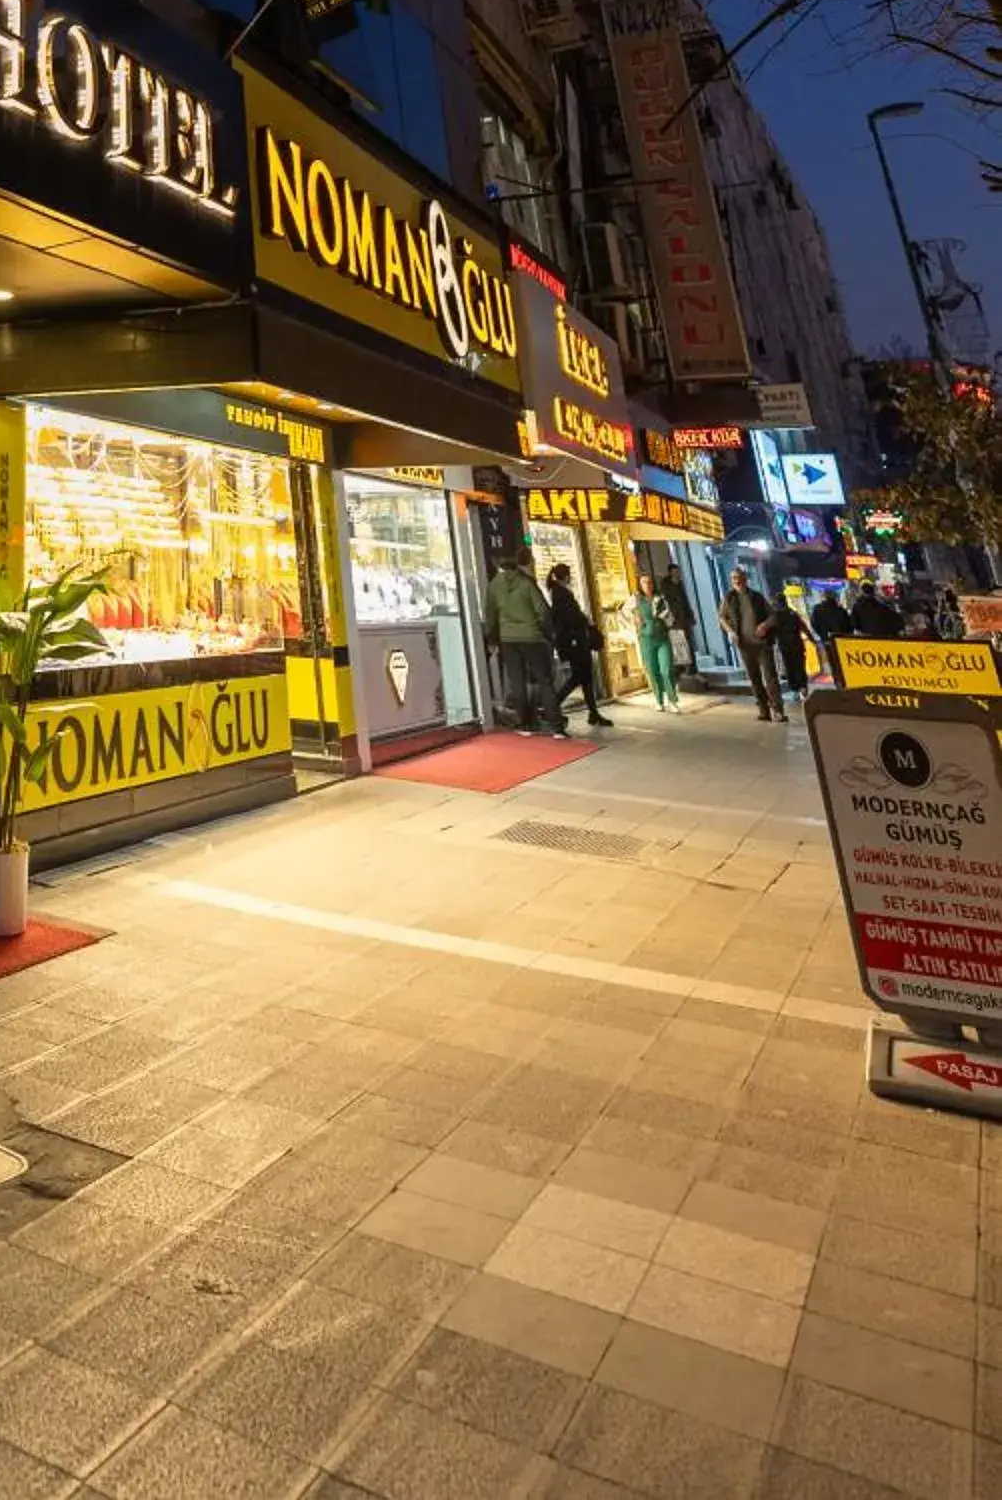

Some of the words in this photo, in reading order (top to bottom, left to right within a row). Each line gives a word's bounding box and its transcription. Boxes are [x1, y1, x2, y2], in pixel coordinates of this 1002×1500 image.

[894, 748, 918, 770] M
[851, 793, 986, 826] MODERNÇAĞ
[885, 819, 963, 851] GÜMÜŞ
[853, 844, 898, 868] GÜMÜŞ
[865, 917, 917, 946] GÜMÜŞ
[919, 926, 973, 952] TAMİRİ
[903, 952, 947, 975] ALTIN
[936, 1059, 999, 1084] PASAJ
